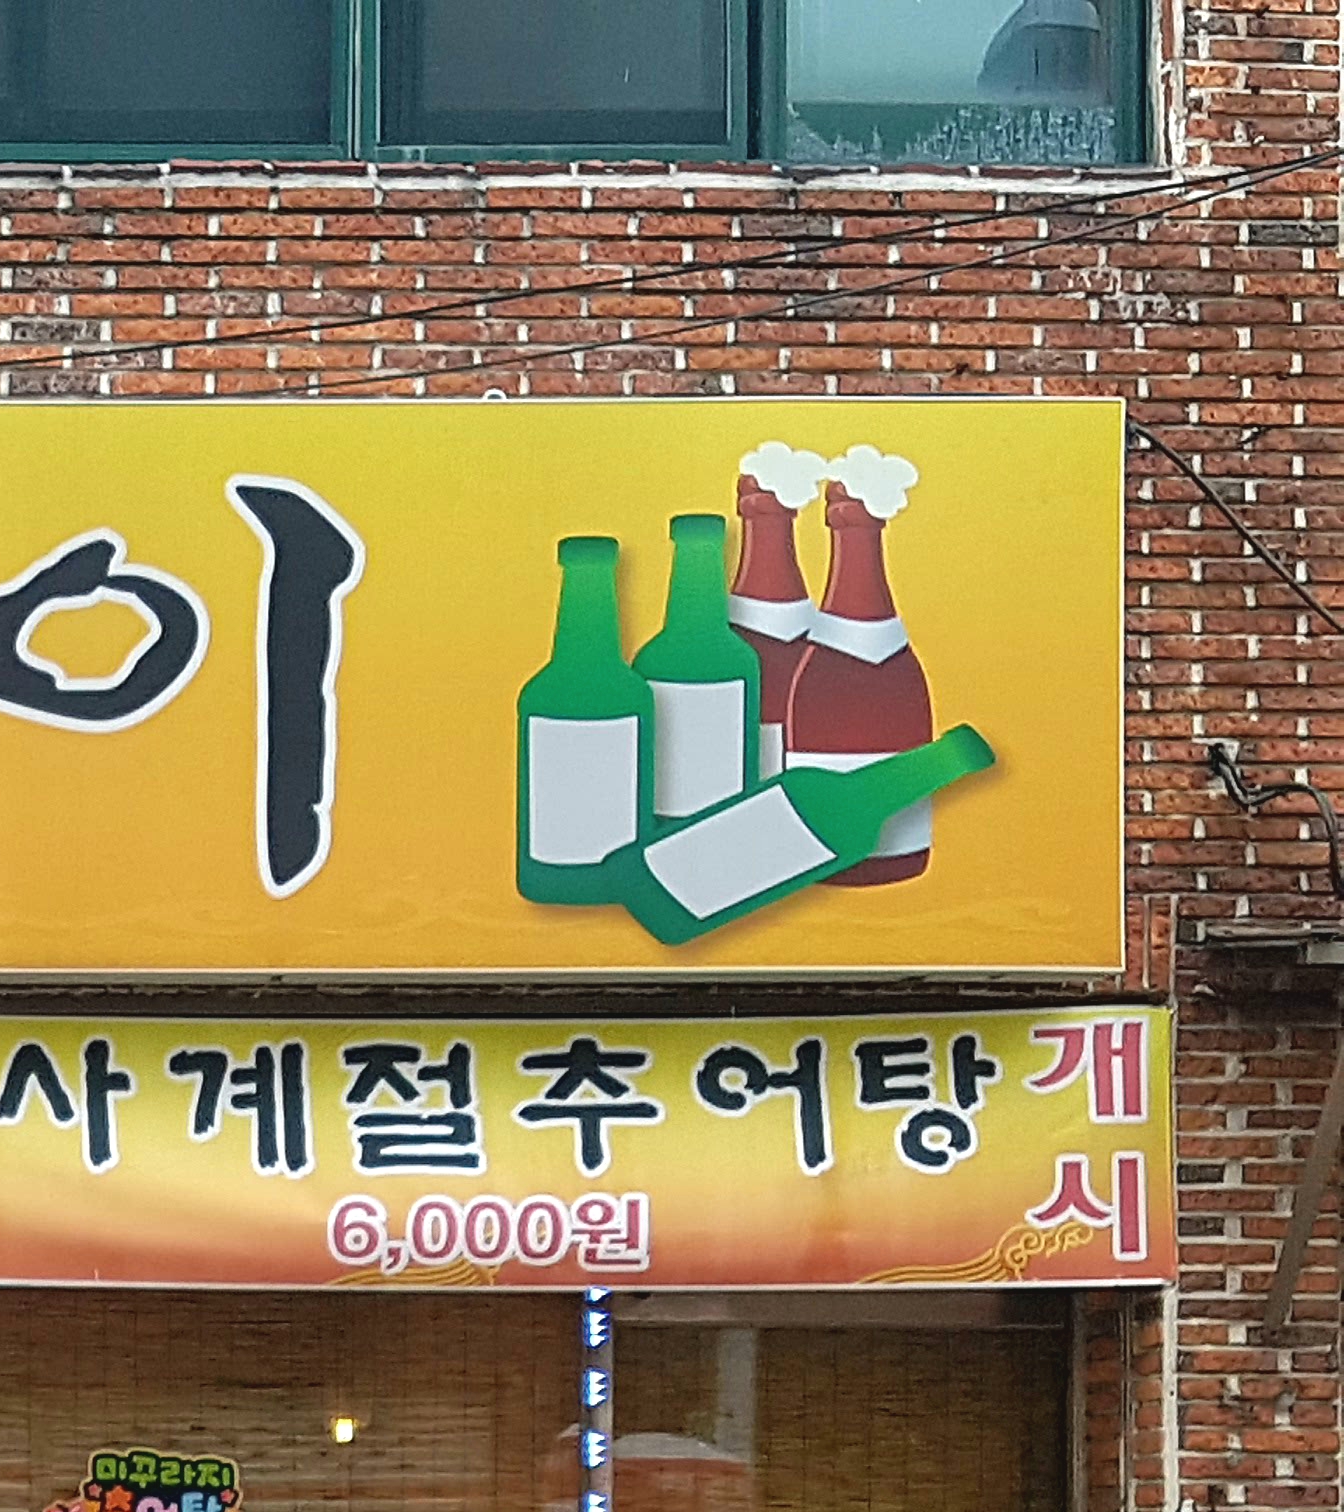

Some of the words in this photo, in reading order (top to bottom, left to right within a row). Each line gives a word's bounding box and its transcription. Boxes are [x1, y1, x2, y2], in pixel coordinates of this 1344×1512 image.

[1025, 1020, 1150, 1261] 개시
[325, 1191, 650, 1277] 6,000원
[95, 1454, 231, 1488] 미꾸라지
